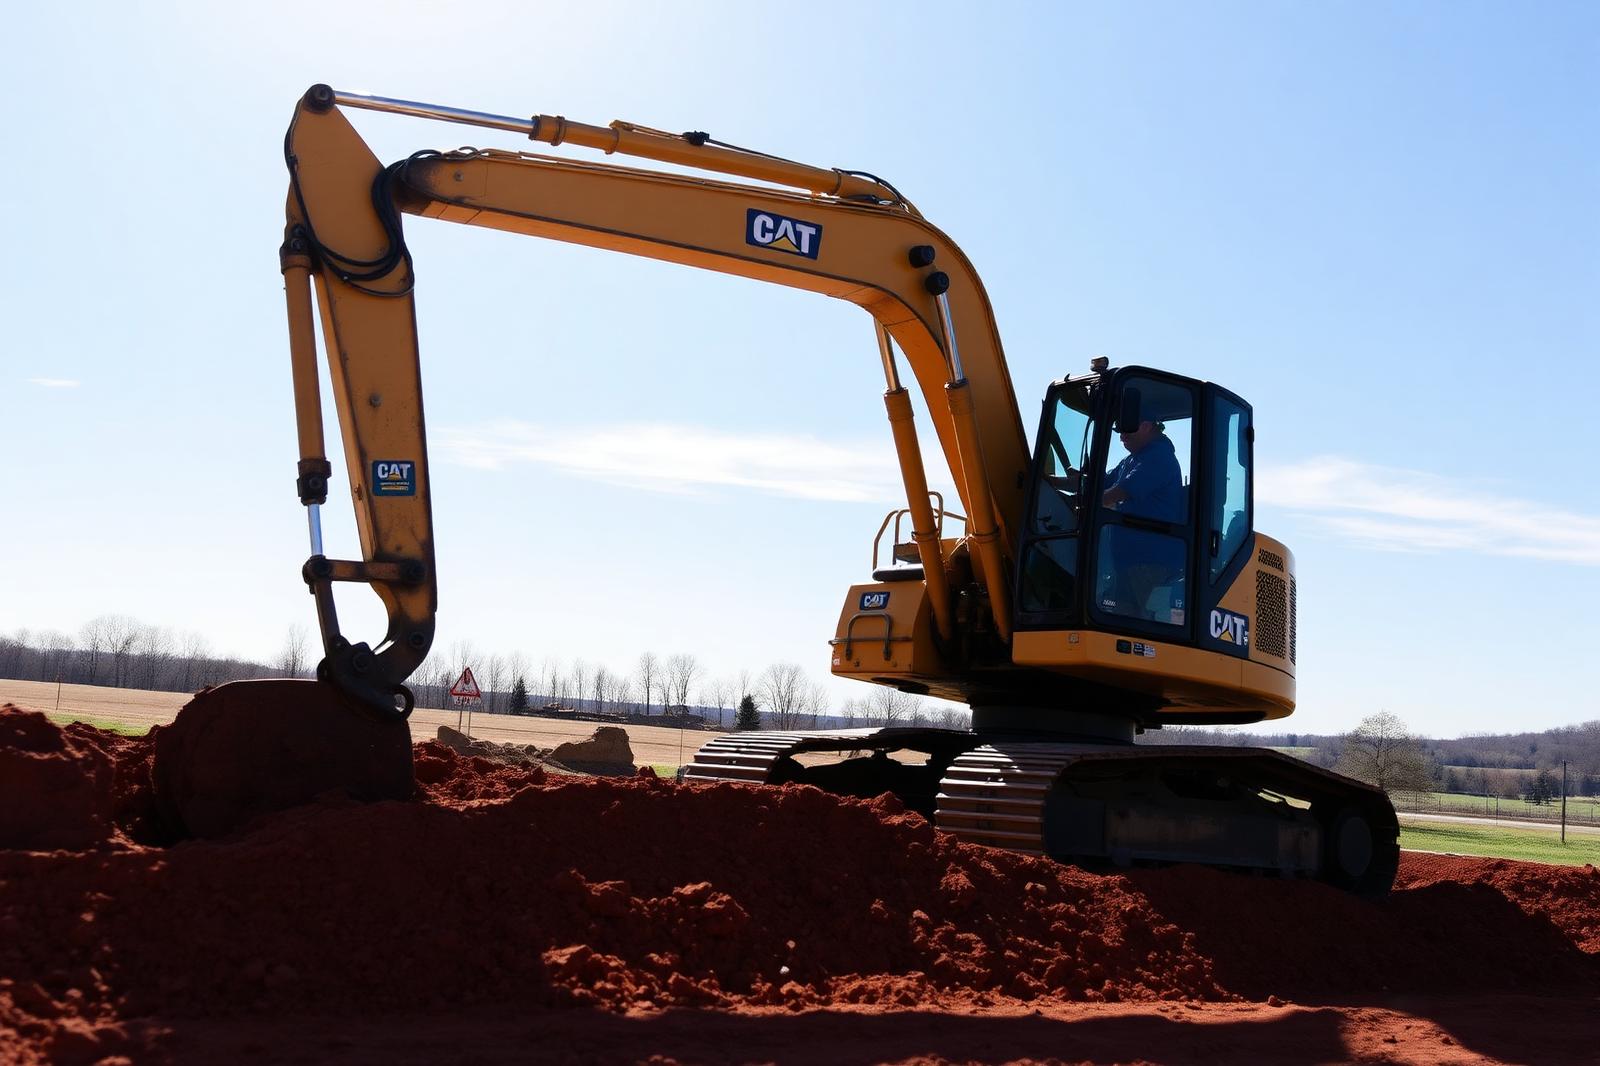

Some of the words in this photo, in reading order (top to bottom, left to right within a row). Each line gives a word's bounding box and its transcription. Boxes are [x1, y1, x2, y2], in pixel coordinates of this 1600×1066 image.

[753, 214, 816, 254] CAT
[377, 463, 411, 479] CAT
[864, 594, 887, 607] CAT
[1210, 610, 1245, 646] CAT
